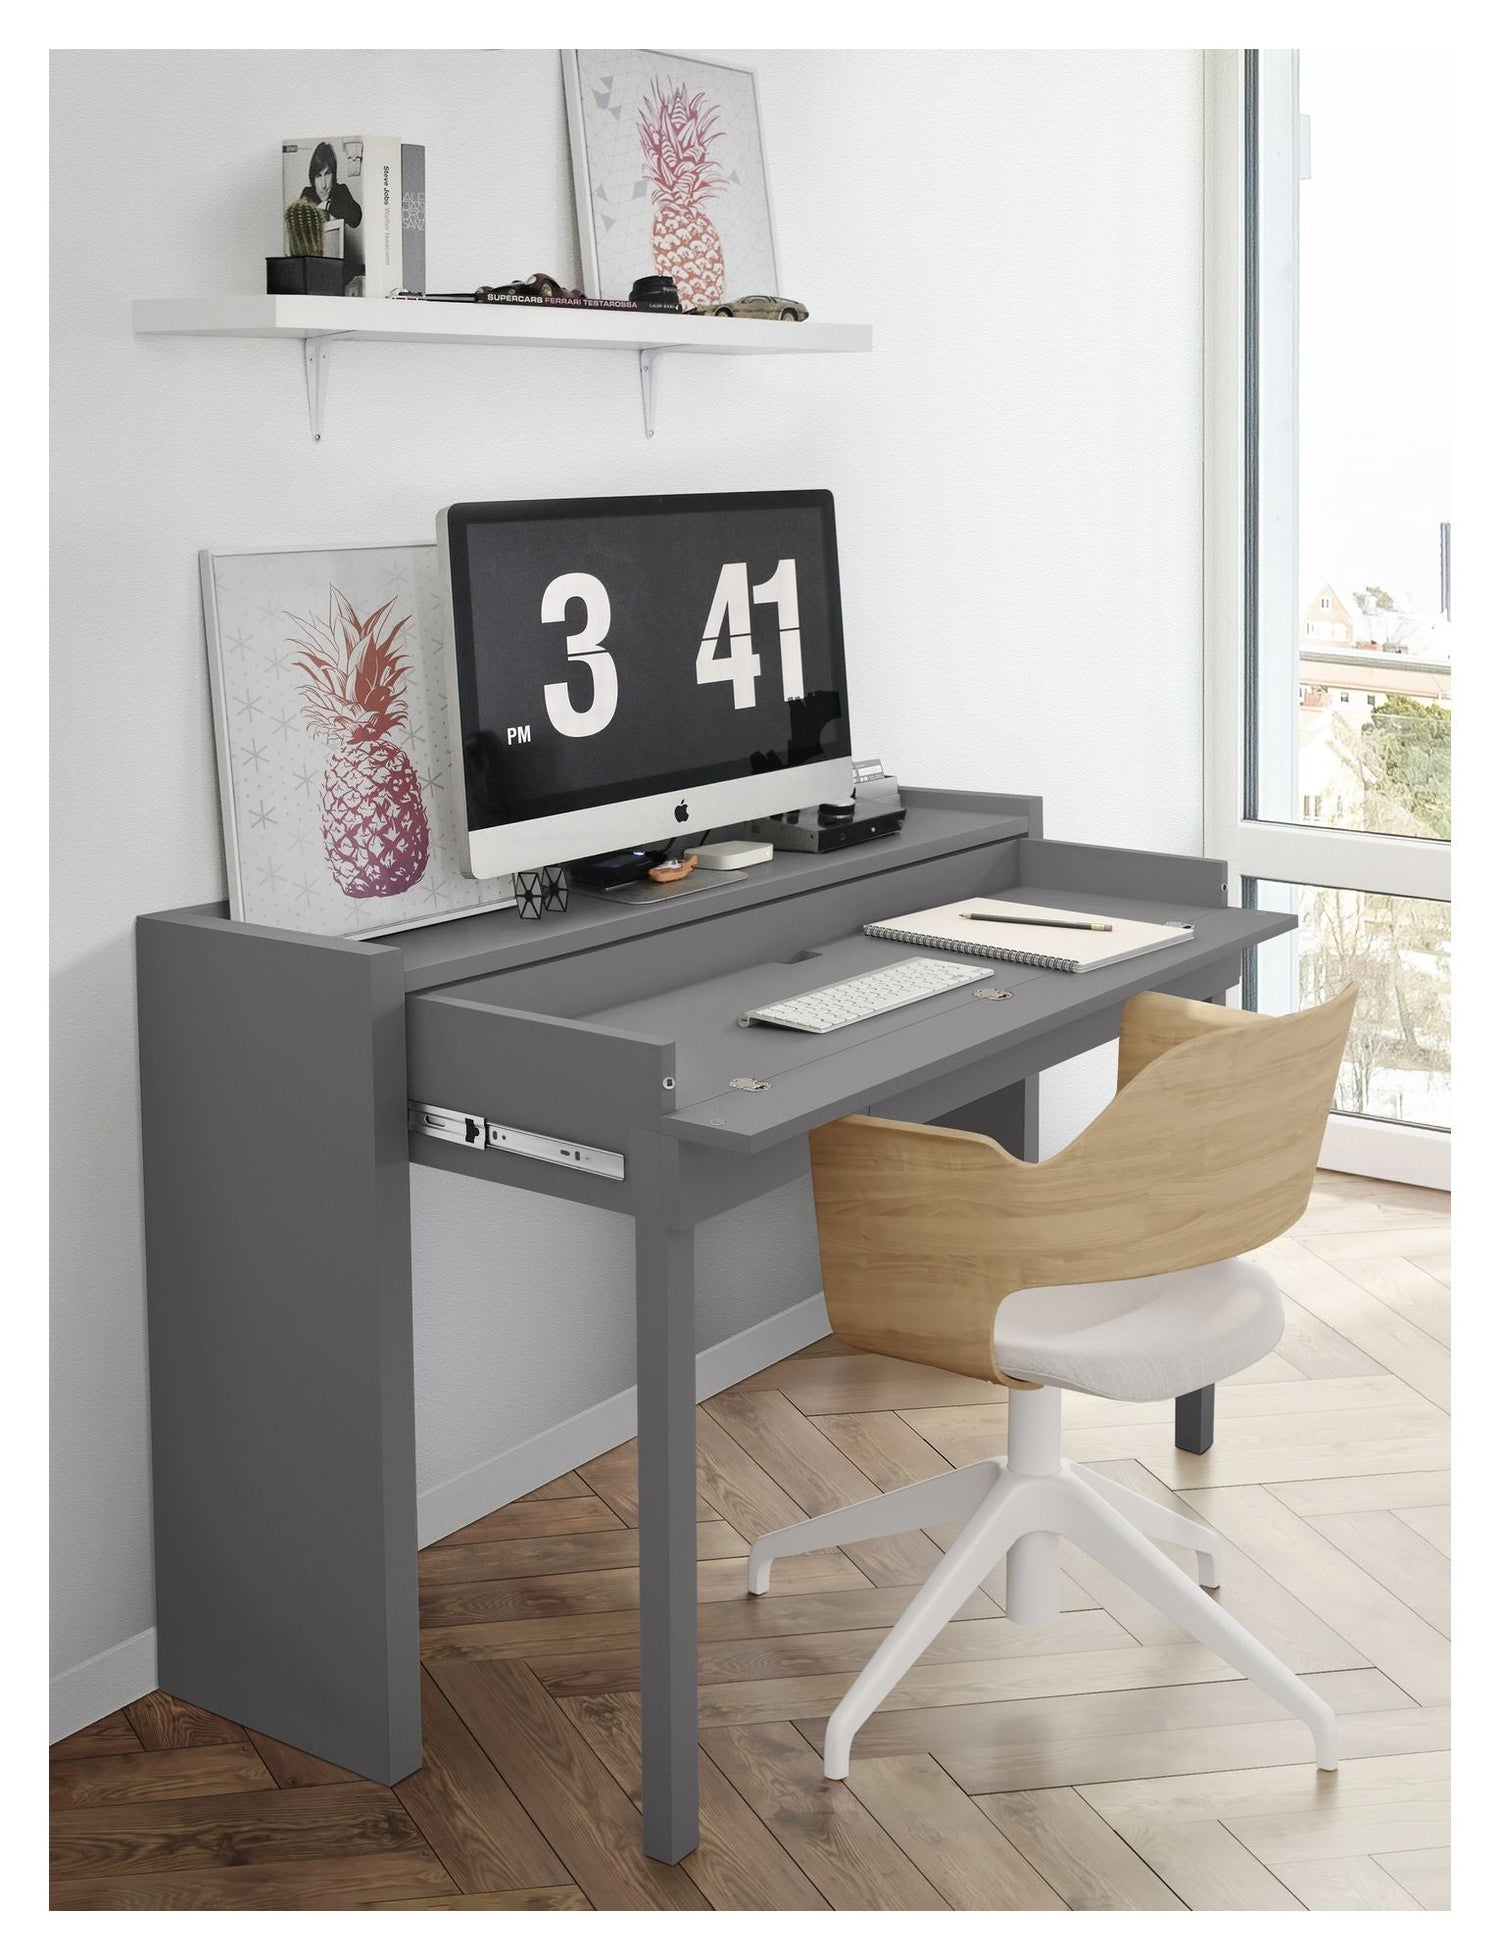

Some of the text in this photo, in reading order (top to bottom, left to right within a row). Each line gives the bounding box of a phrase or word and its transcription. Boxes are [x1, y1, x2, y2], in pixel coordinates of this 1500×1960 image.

[487, 293, 543, 304] SUPERCARS
[544, 296, 582, 306] FERRARI
[583, 299, 638, 309] TESTAROSSA
[540, 558, 805, 738] 3 41
[506, 724, 532, 745] PM
